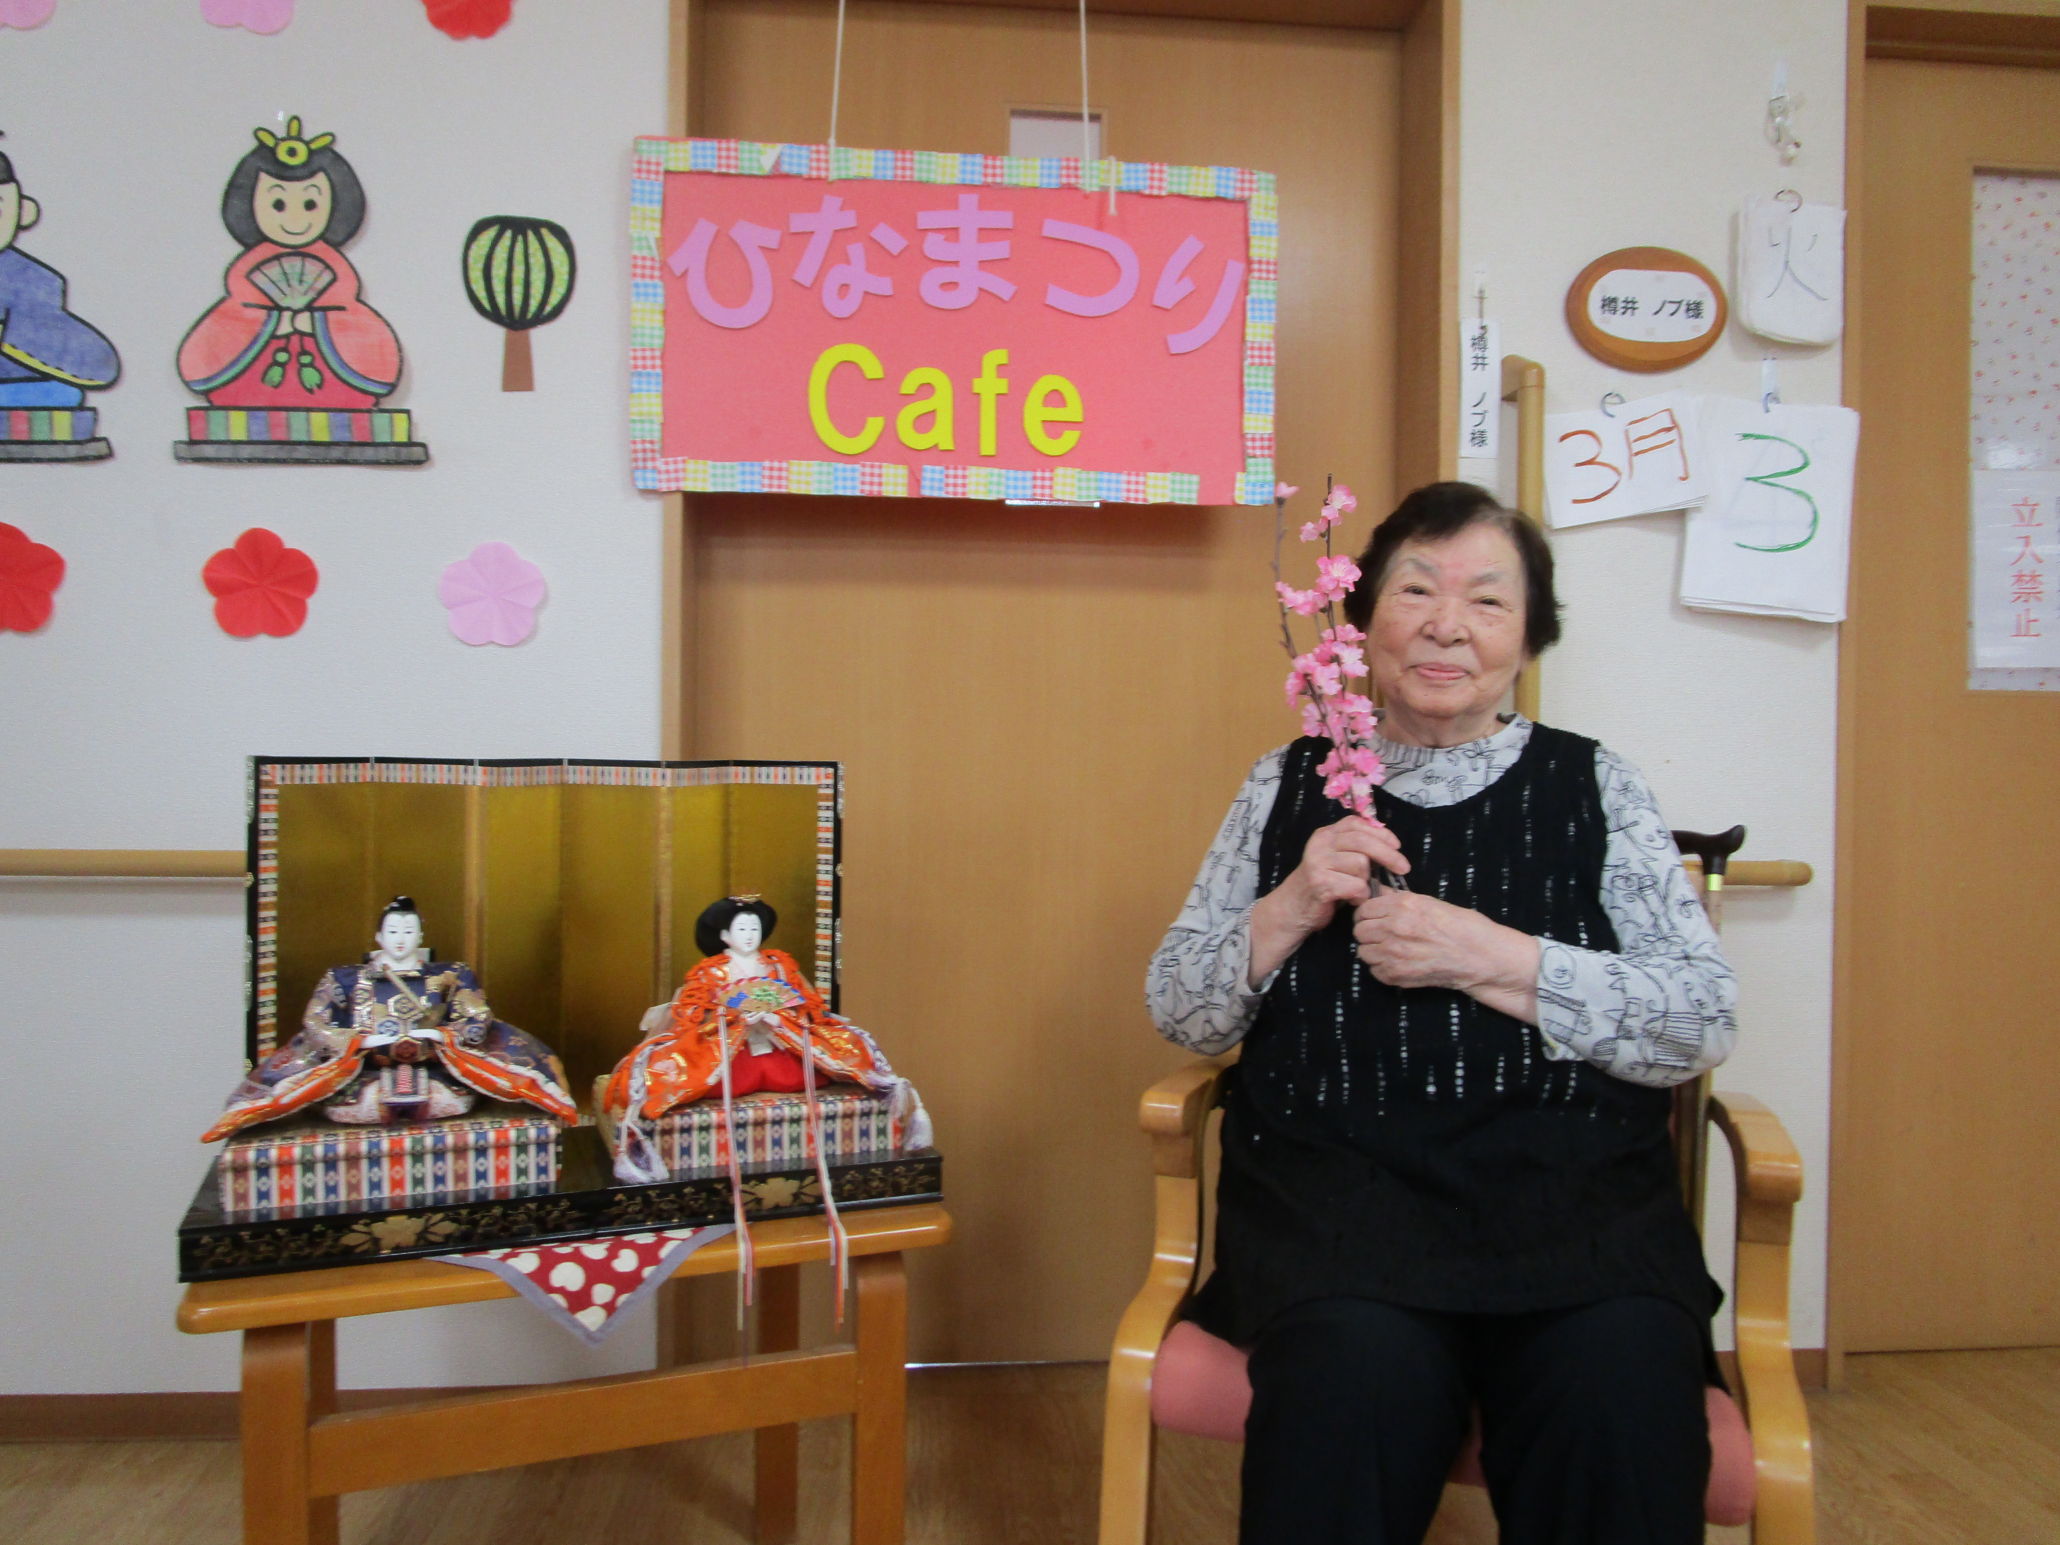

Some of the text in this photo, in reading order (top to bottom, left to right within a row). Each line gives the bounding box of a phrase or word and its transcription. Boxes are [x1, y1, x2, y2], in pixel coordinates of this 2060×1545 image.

[667, 194, 1244, 354] ひなまつり
[1765, 226, 1829, 301] 火
[807, 343, 1084, 457] Cafe
[1558, 408, 1690, 504] 3月
[1736, 432, 1820, 553] 3
[2010, 496, 2045, 638] 立入禁止
